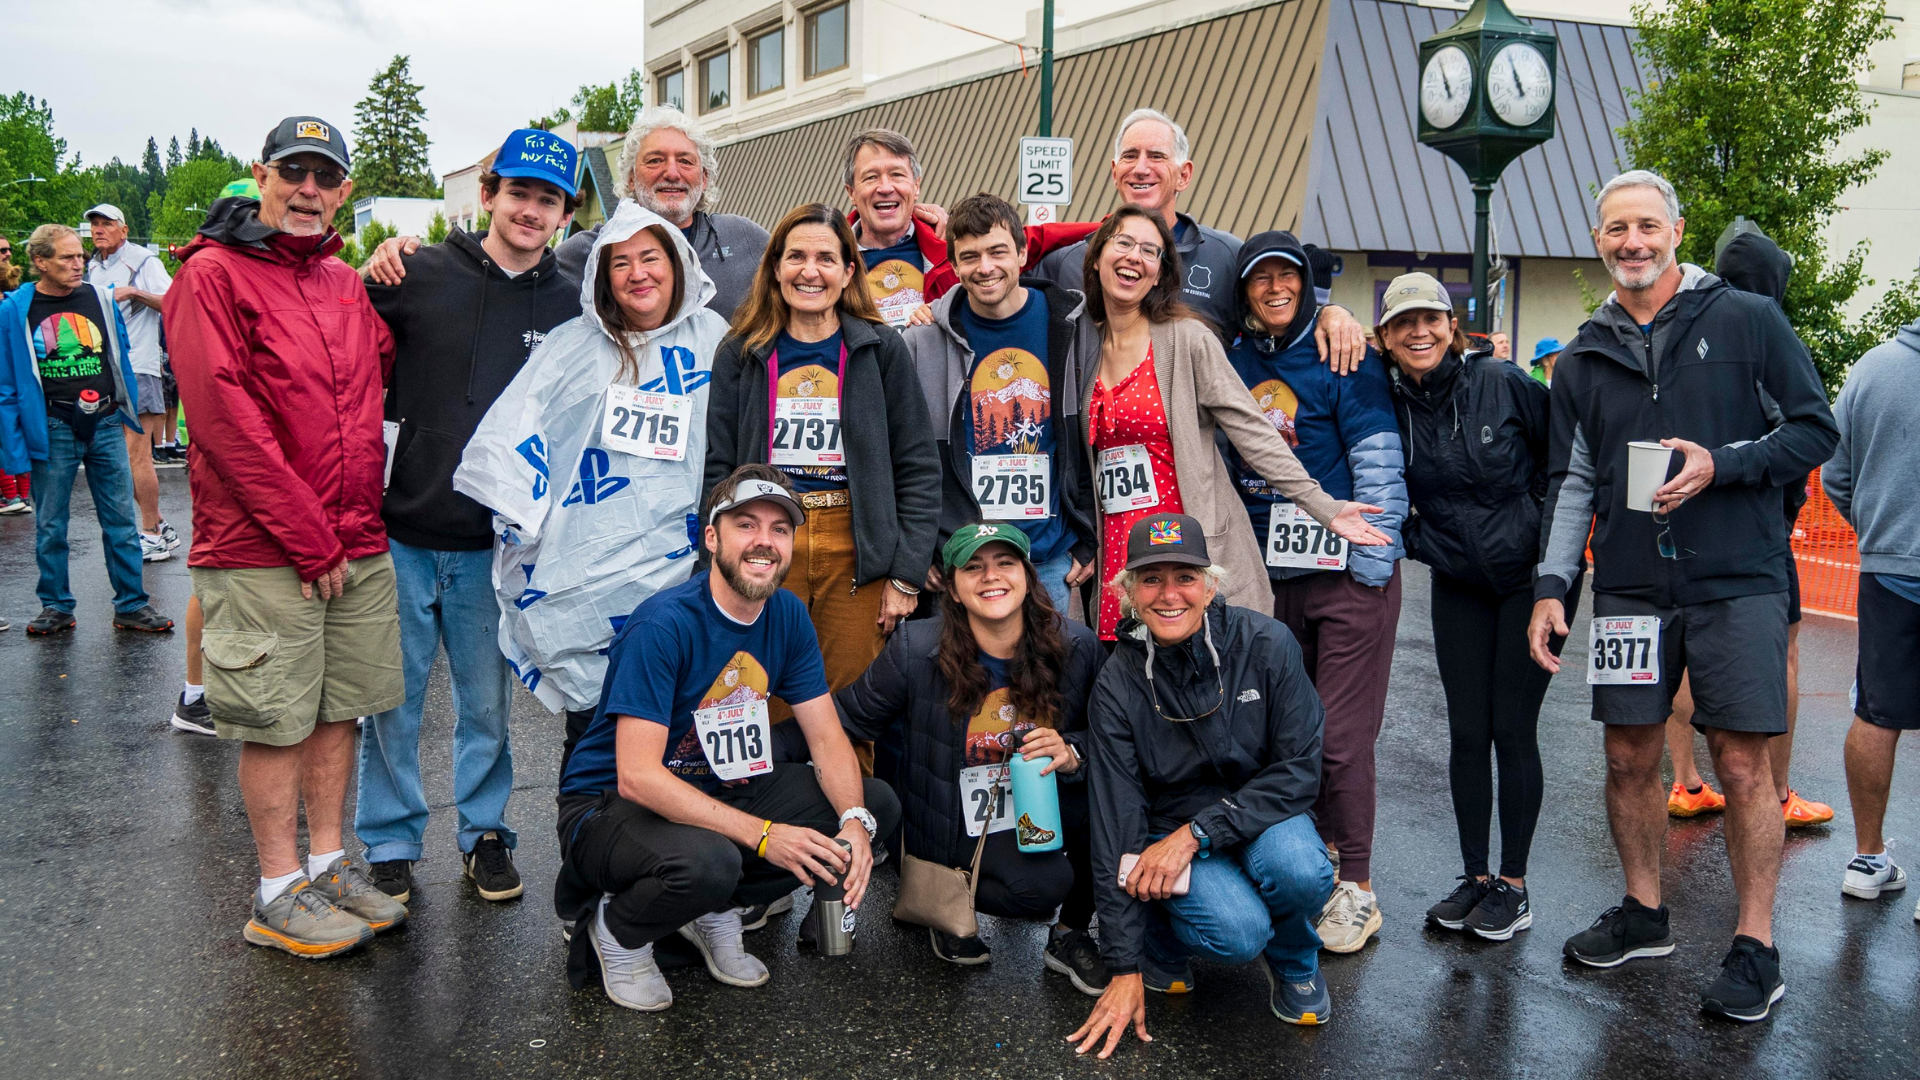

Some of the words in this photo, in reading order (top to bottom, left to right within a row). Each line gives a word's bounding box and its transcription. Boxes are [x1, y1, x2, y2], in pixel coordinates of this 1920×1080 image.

[1491, 64, 1503, 76] 20
[1534, 86, 1549, 97] 100
[1524, 104, 1543, 118] 120
[1026, 145, 1067, 157] SPEED
[1029, 159, 1062, 170] LIMIT
[1026, 172, 1064, 196] 25
[644, 395, 665, 406] JULY
[803, 402, 823, 410] JULY
[610, 406, 679, 446] 2715
[772, 417, 841, 451] 2737
[1009, 458, 1027, 467] JULY
[1098, 463, 1150, 500] 2734
[977, 474, 1045, 505] 2735
[1273, 523, 1342, 556] 3378
[1615, 621, 1633, 629] JULY
[1594, 637, 1651, 670] 3377
[727, 707, 745, 719] JULY
[706, 723, 763, 766] 2713
[682, 767, 694, 775] OF
[694, 767, 710, 775] JULY
